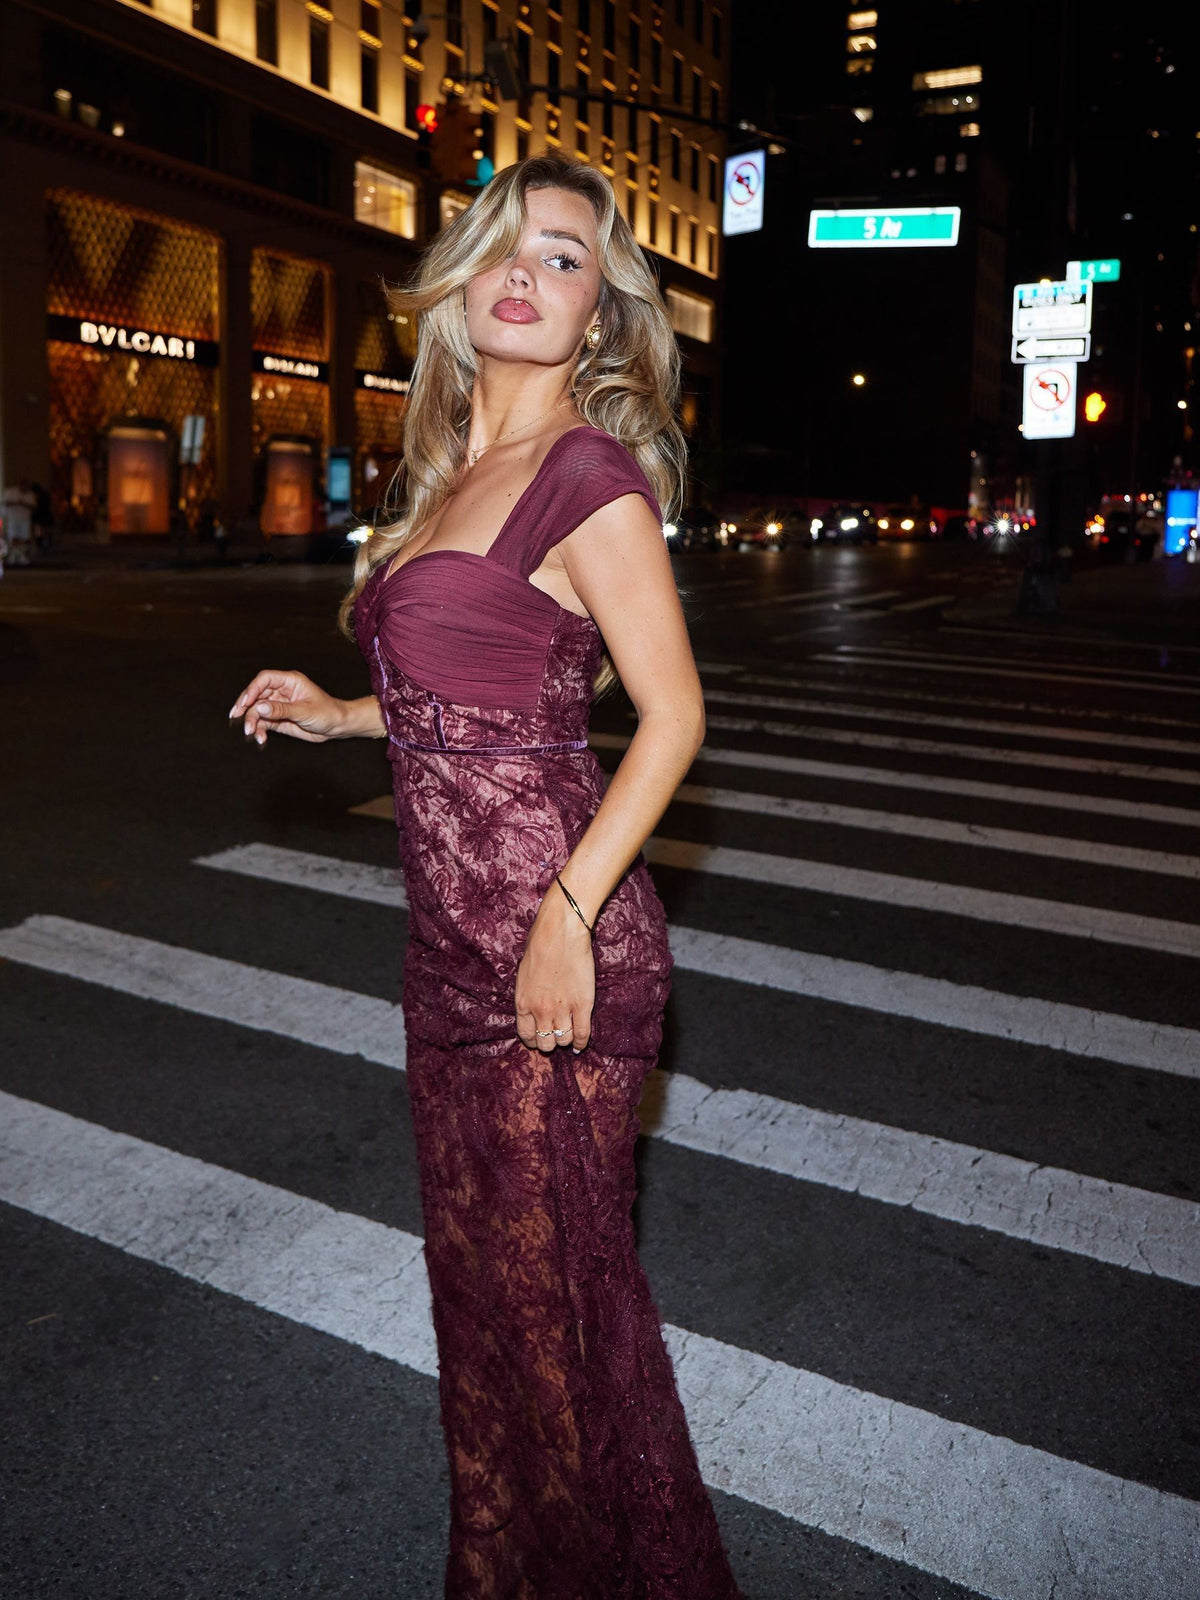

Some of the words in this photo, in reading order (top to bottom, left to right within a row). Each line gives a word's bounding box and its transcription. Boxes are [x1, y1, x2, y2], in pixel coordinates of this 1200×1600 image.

[863, 216, 877, 239] 5
[880, 216, 903, 239] Av
[80, 321, 195, 360] BVLGARI
